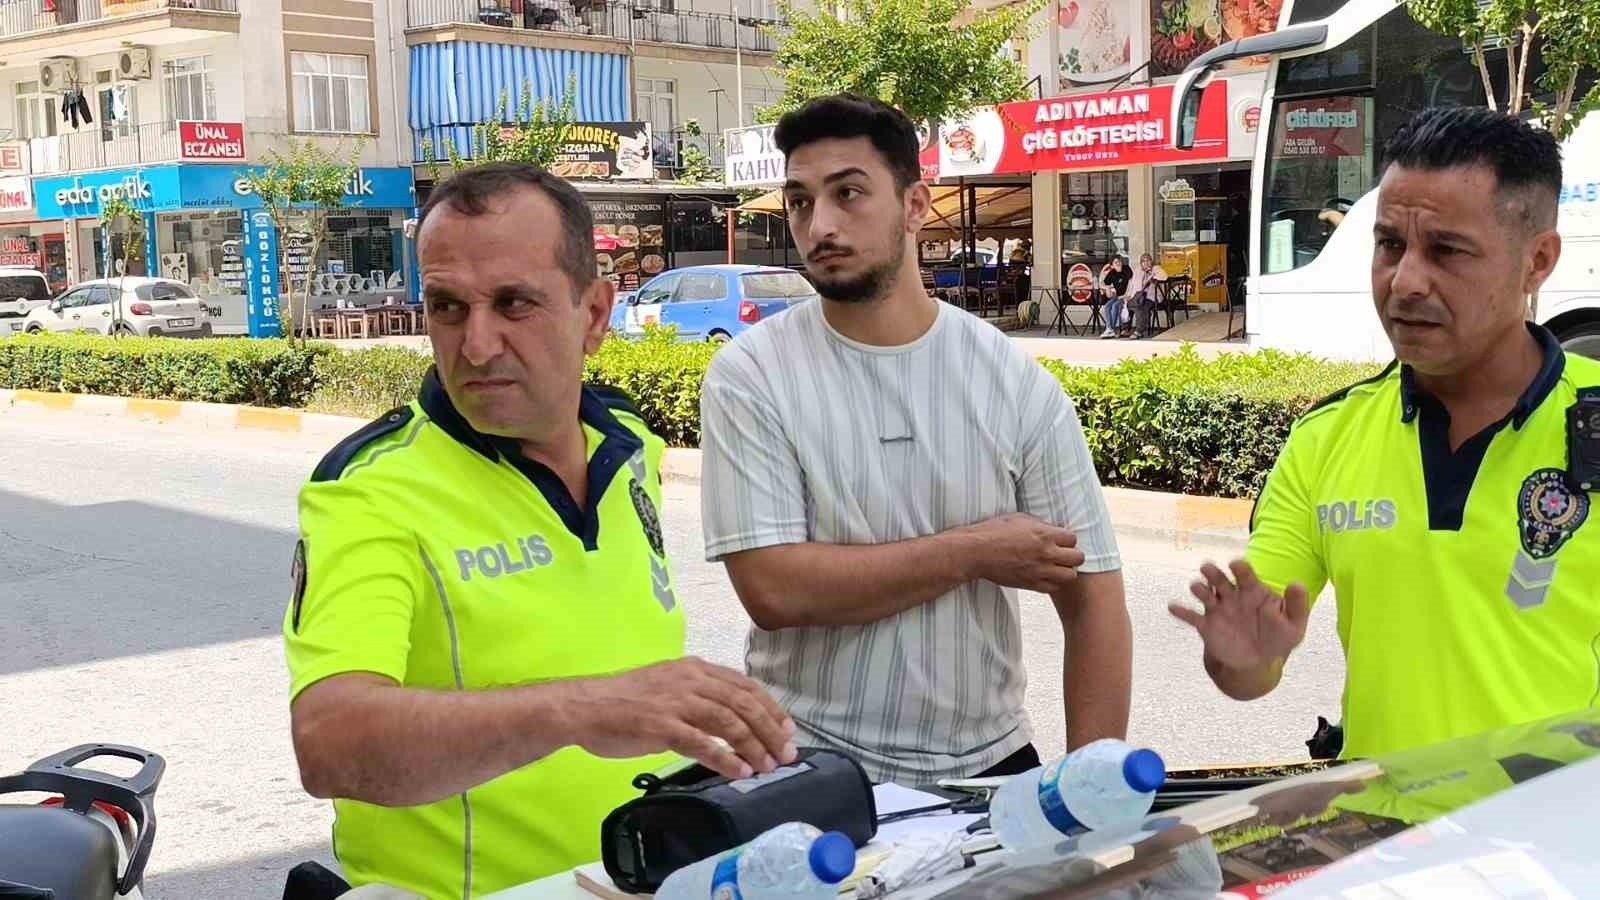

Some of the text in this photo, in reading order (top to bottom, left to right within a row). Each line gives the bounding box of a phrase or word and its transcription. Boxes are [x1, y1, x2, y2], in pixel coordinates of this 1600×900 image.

[1035, 94, 1150, 123] ADIYAMAN
[195, 123, 229, 140] ÜNAL
[1022, 118, 1164, 154] ÇİĞ KÖFTECİSİ
[184, 139, 242, 157] ECZANESİ
[732, 157, 782, 181] KAHV
[55, 177, 93, 206] eda
